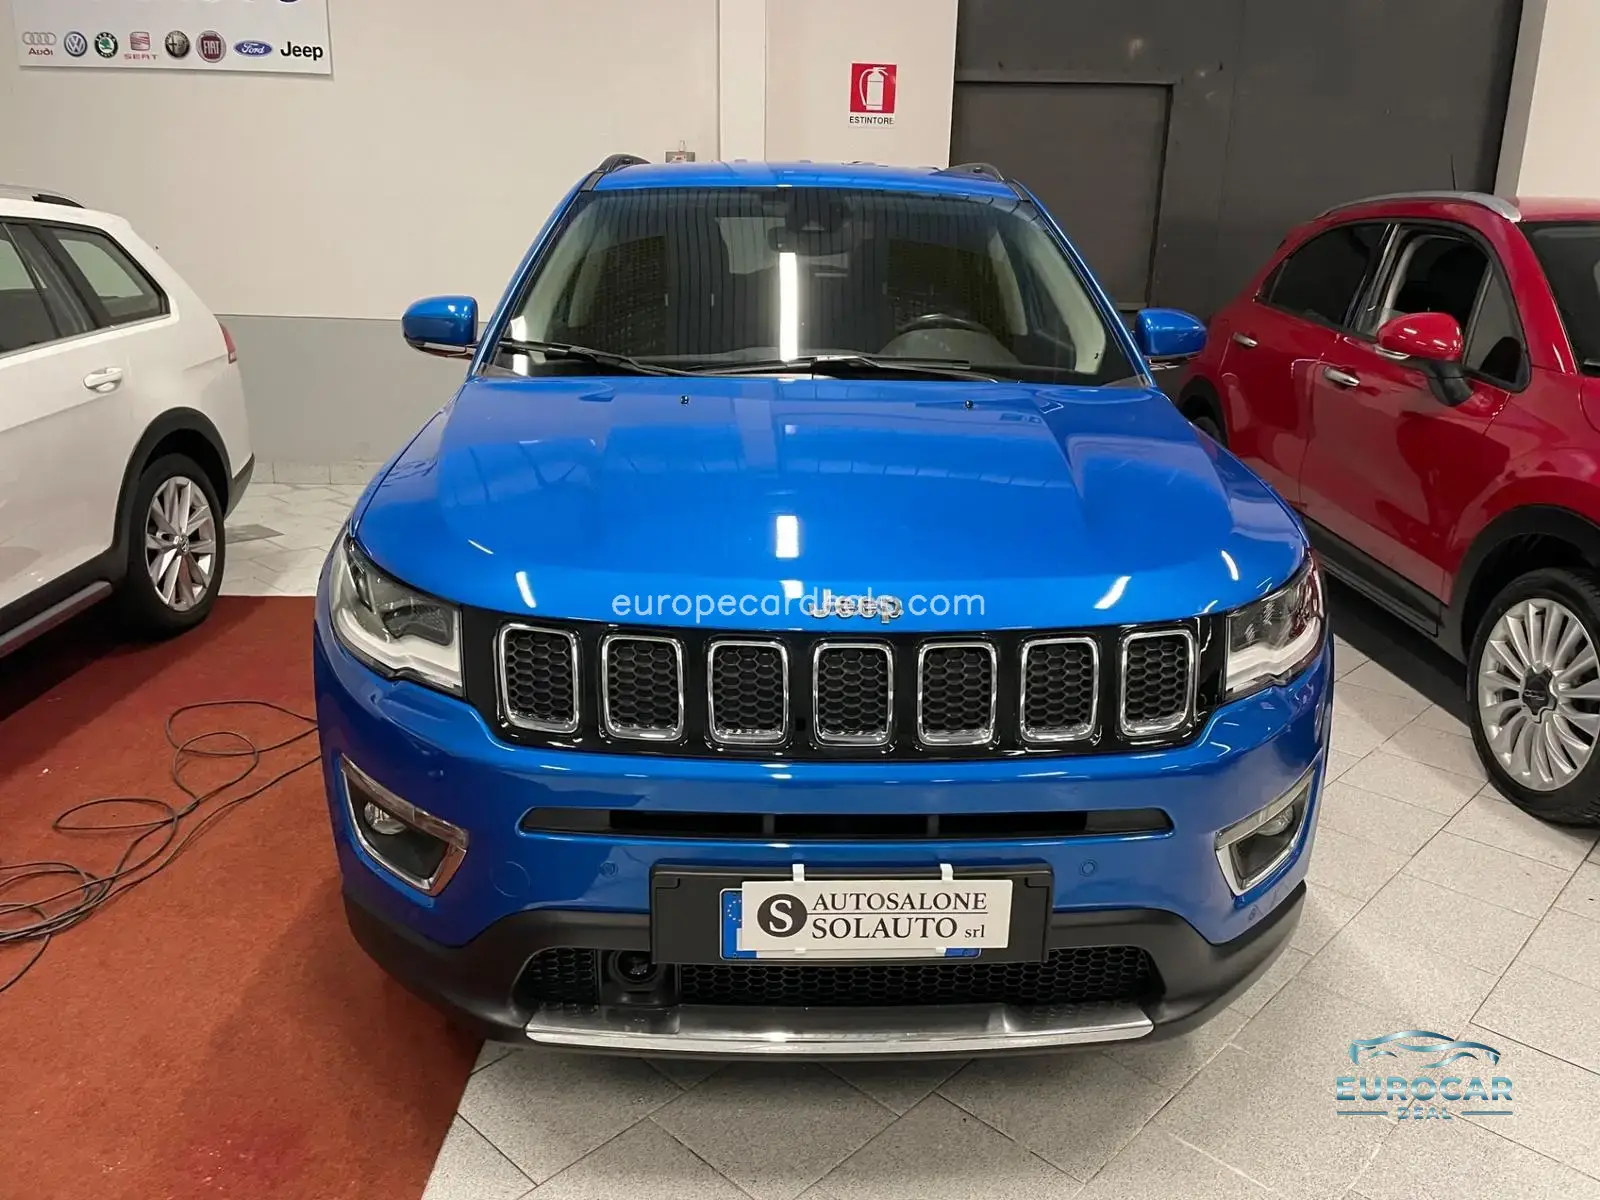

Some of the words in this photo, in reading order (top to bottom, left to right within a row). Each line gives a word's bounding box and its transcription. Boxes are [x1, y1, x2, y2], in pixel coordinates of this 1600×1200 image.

[28, 47, 54, 56] Audi
[203, 40, 220, 55] FIAT
[241, 43, 266, 54] Ford
[280, 41, 324, 61] Jeep
[849, 116, 895, 125] ESTINTORE
[808, 588, 904, 624] Jeep
[811, 892, 988, 911] AUTOSALONE
[811, 917, 958, 939] SOLAUTO
[964, 924, 985, 938] srl
